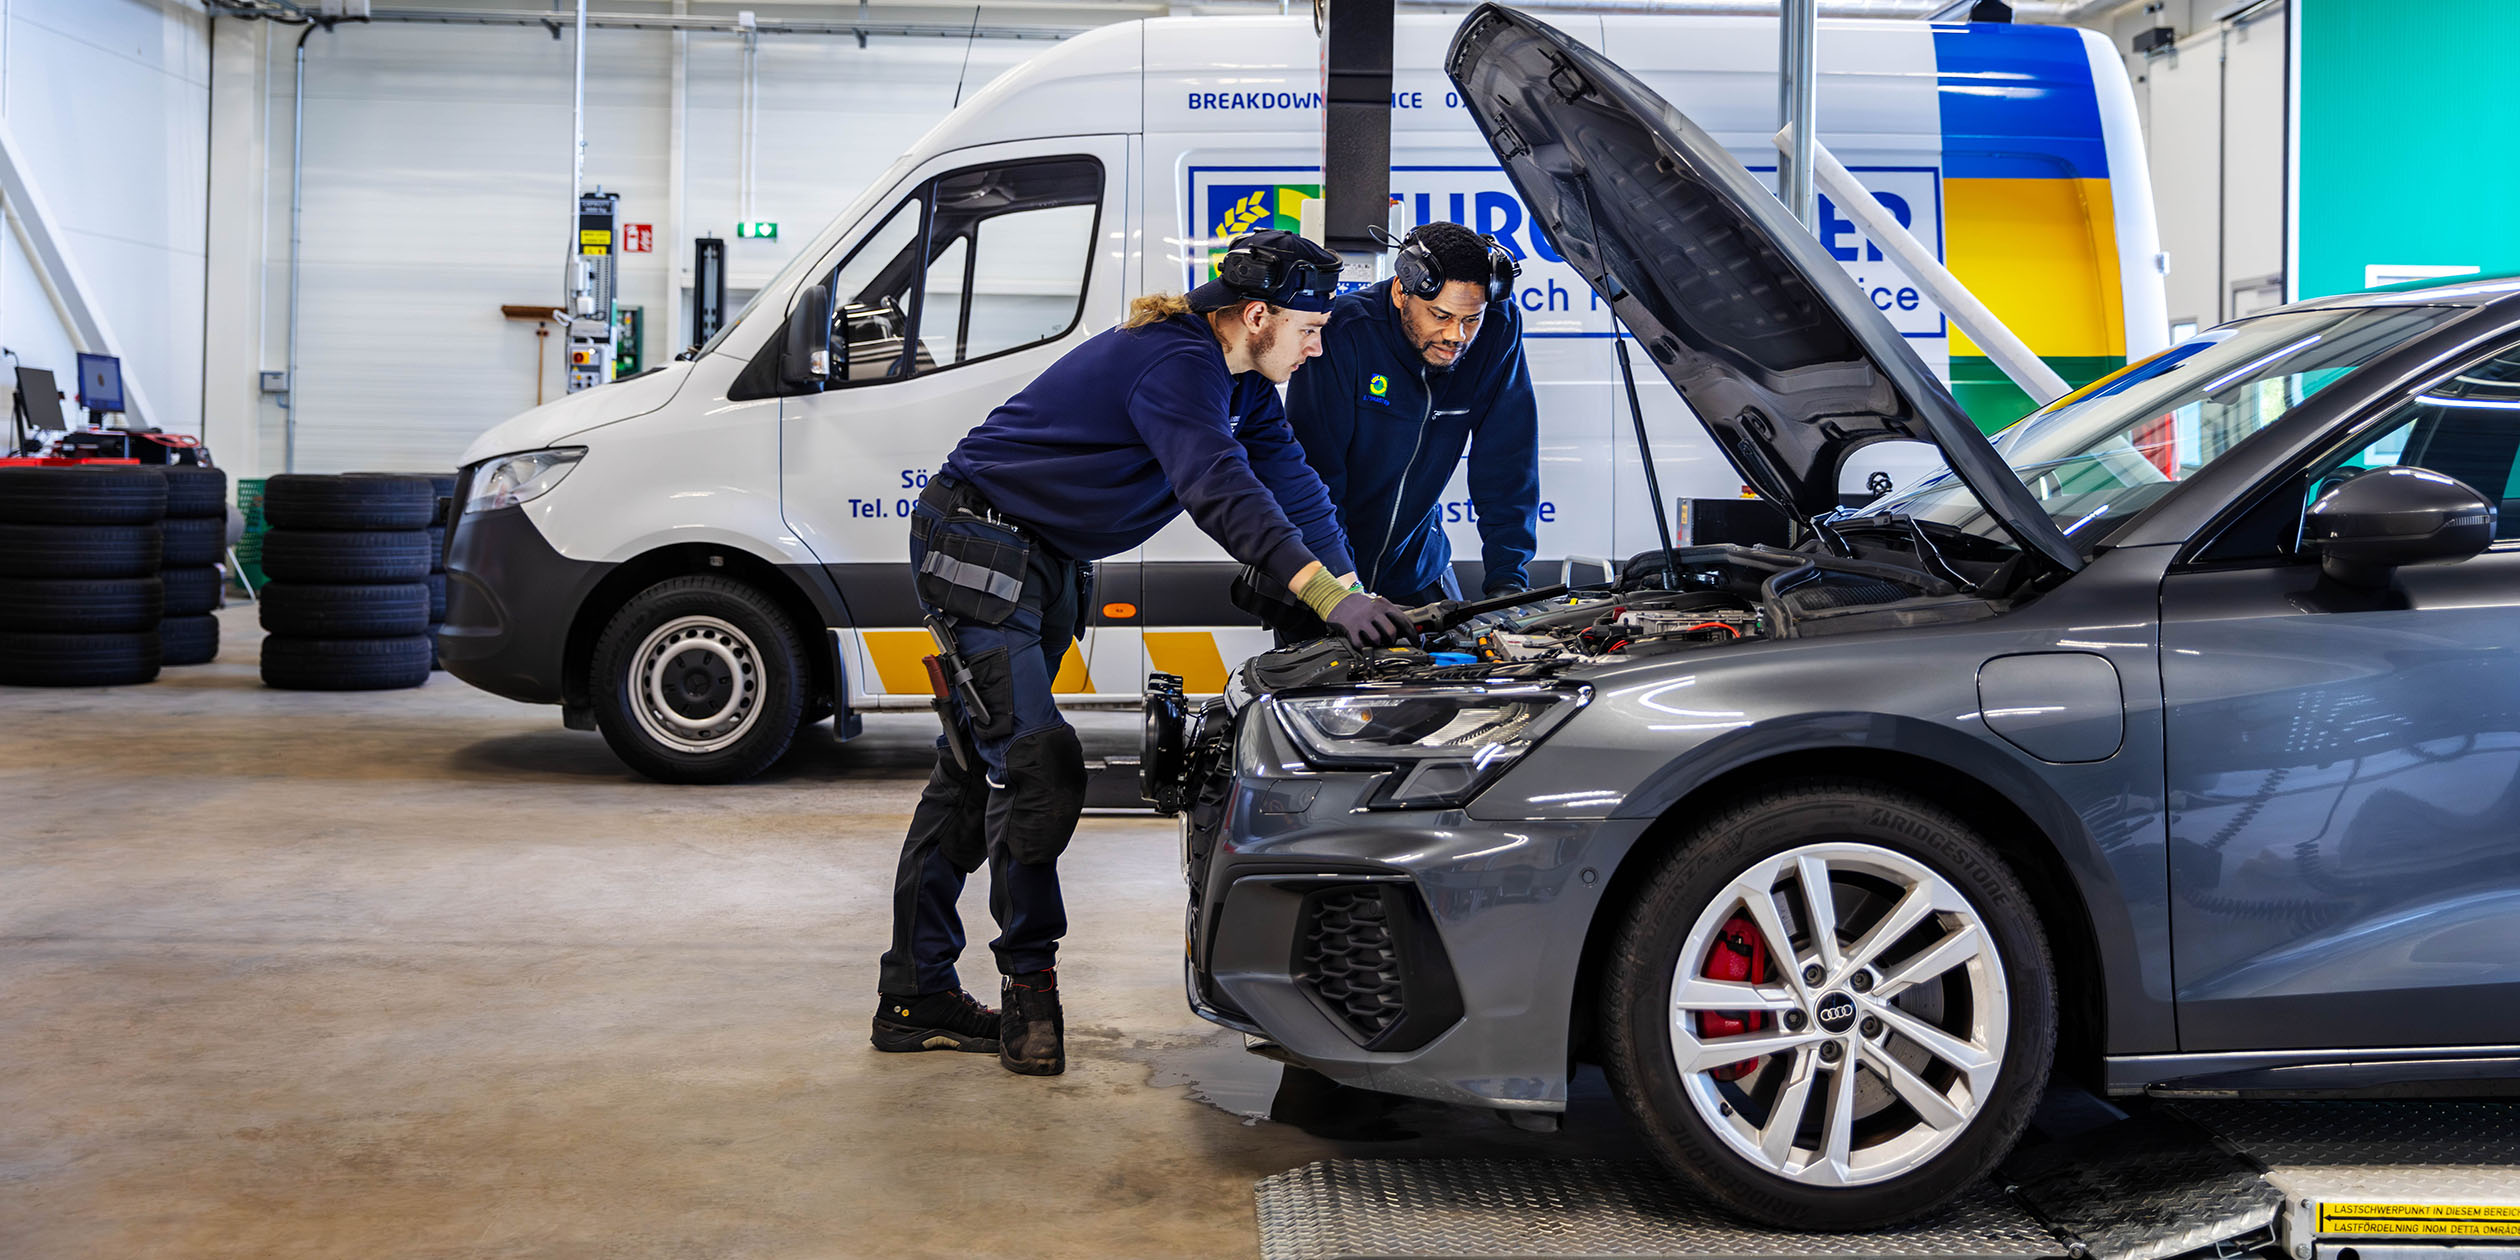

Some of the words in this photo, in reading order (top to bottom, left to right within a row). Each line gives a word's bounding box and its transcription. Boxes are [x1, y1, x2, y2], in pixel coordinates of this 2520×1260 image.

[848, 498, 888, 518] Tel.
[2334, 1205, 2430, 1216] LASTSCHWERPUNKT
[2433, 1207, 2443, 1215] IN
[2446, 1207, 2481, 1216] DIESEM
[2334, 1222, 2419, 1233] LASTFÖRDELNING
[2422, 1224, 2447, 1233] INOM
[2450, 1225, 2480, 1234] DETTA
